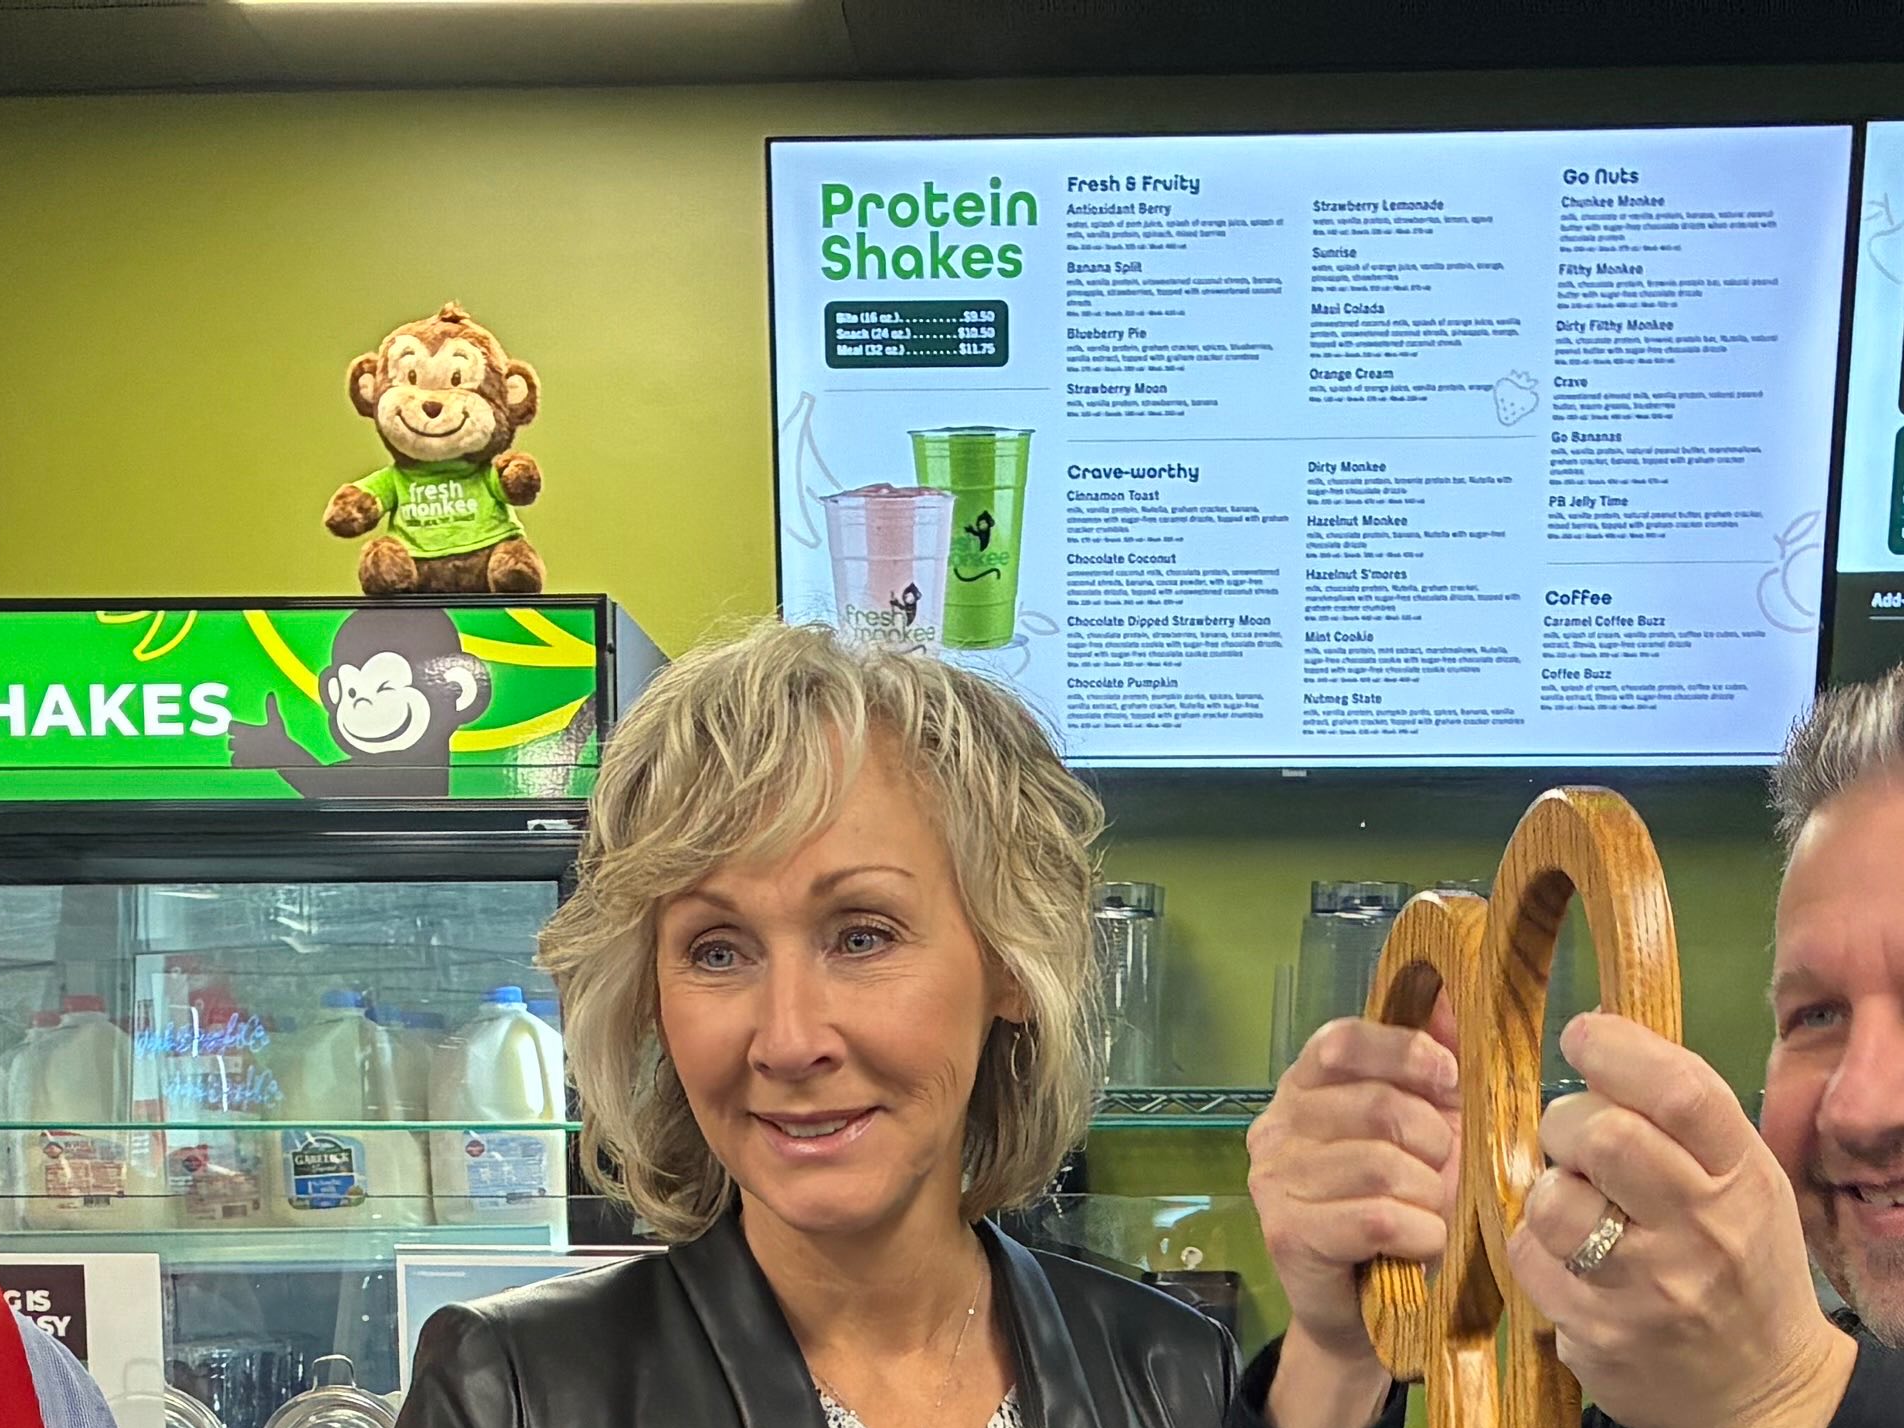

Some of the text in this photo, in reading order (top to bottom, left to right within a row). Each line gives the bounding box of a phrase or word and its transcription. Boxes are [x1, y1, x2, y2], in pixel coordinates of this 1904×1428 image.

[1562, 167, 1640, 185] Go Nuts
[1067, 173, 1201, 196] Fresh & Fruity
[820, 176, 1038, 228] Protein
[1066, 202, 1172, 217] Antioxidant Berry
[1312, 199, 1445, 214] Strawberry Lemonade
[820, 231, 1023, 281] Shakes
[1311, 246, 1358, 259] Sunrise
[1066, 261, 1143, 275] Banana Split
[1310, 302, 1385, 315] Maui Colada
[1066, 327, 1147, 342] Blueberry Pie
[1309, 367, 1395, 382] Orange Cream
[1553, 375, 1589, 388] Crave
[1066, 382, 1168, 397] Strawberry Moon
[1551, 431, 1622, 444] Go Bananas
[1067, 462, 1200, 483] Crave-worthy
[1307, 461, 1387, 475] Dirty Monkee
[410, 481, 463, 502] fresh
[1066, 489, 1160, 502] Cinnamon Toast
[400, 499, 479, 519] monkee
[1306, 514, 1408, 527] Hazelnut Monkee
[1066, 552, 1177, 565] Chocolate Coconut
[1305, 568, 1408, 581] Hazelnut S'mores
[1545, 589, 1613, 606] Coffee
[845, 604, 907, 627] fresh
[1066, 614, 1272, 629] Chocolate Dipped Strawberry Moon
[1543, 614, 1666, 628] Caramel Coffee Buzz
[1304, 630, 1374, 643] Mint Cookie
[1541, 667, 1612, 680] Coffee Buzz
[1066, 676, 1179, 690] Chocolate Pumpkin
[1303, 692, 1383, 707] Nutmeg State
[26, 1290, 51, 1312] IS
[36, 1315, 71, 1337] SY
